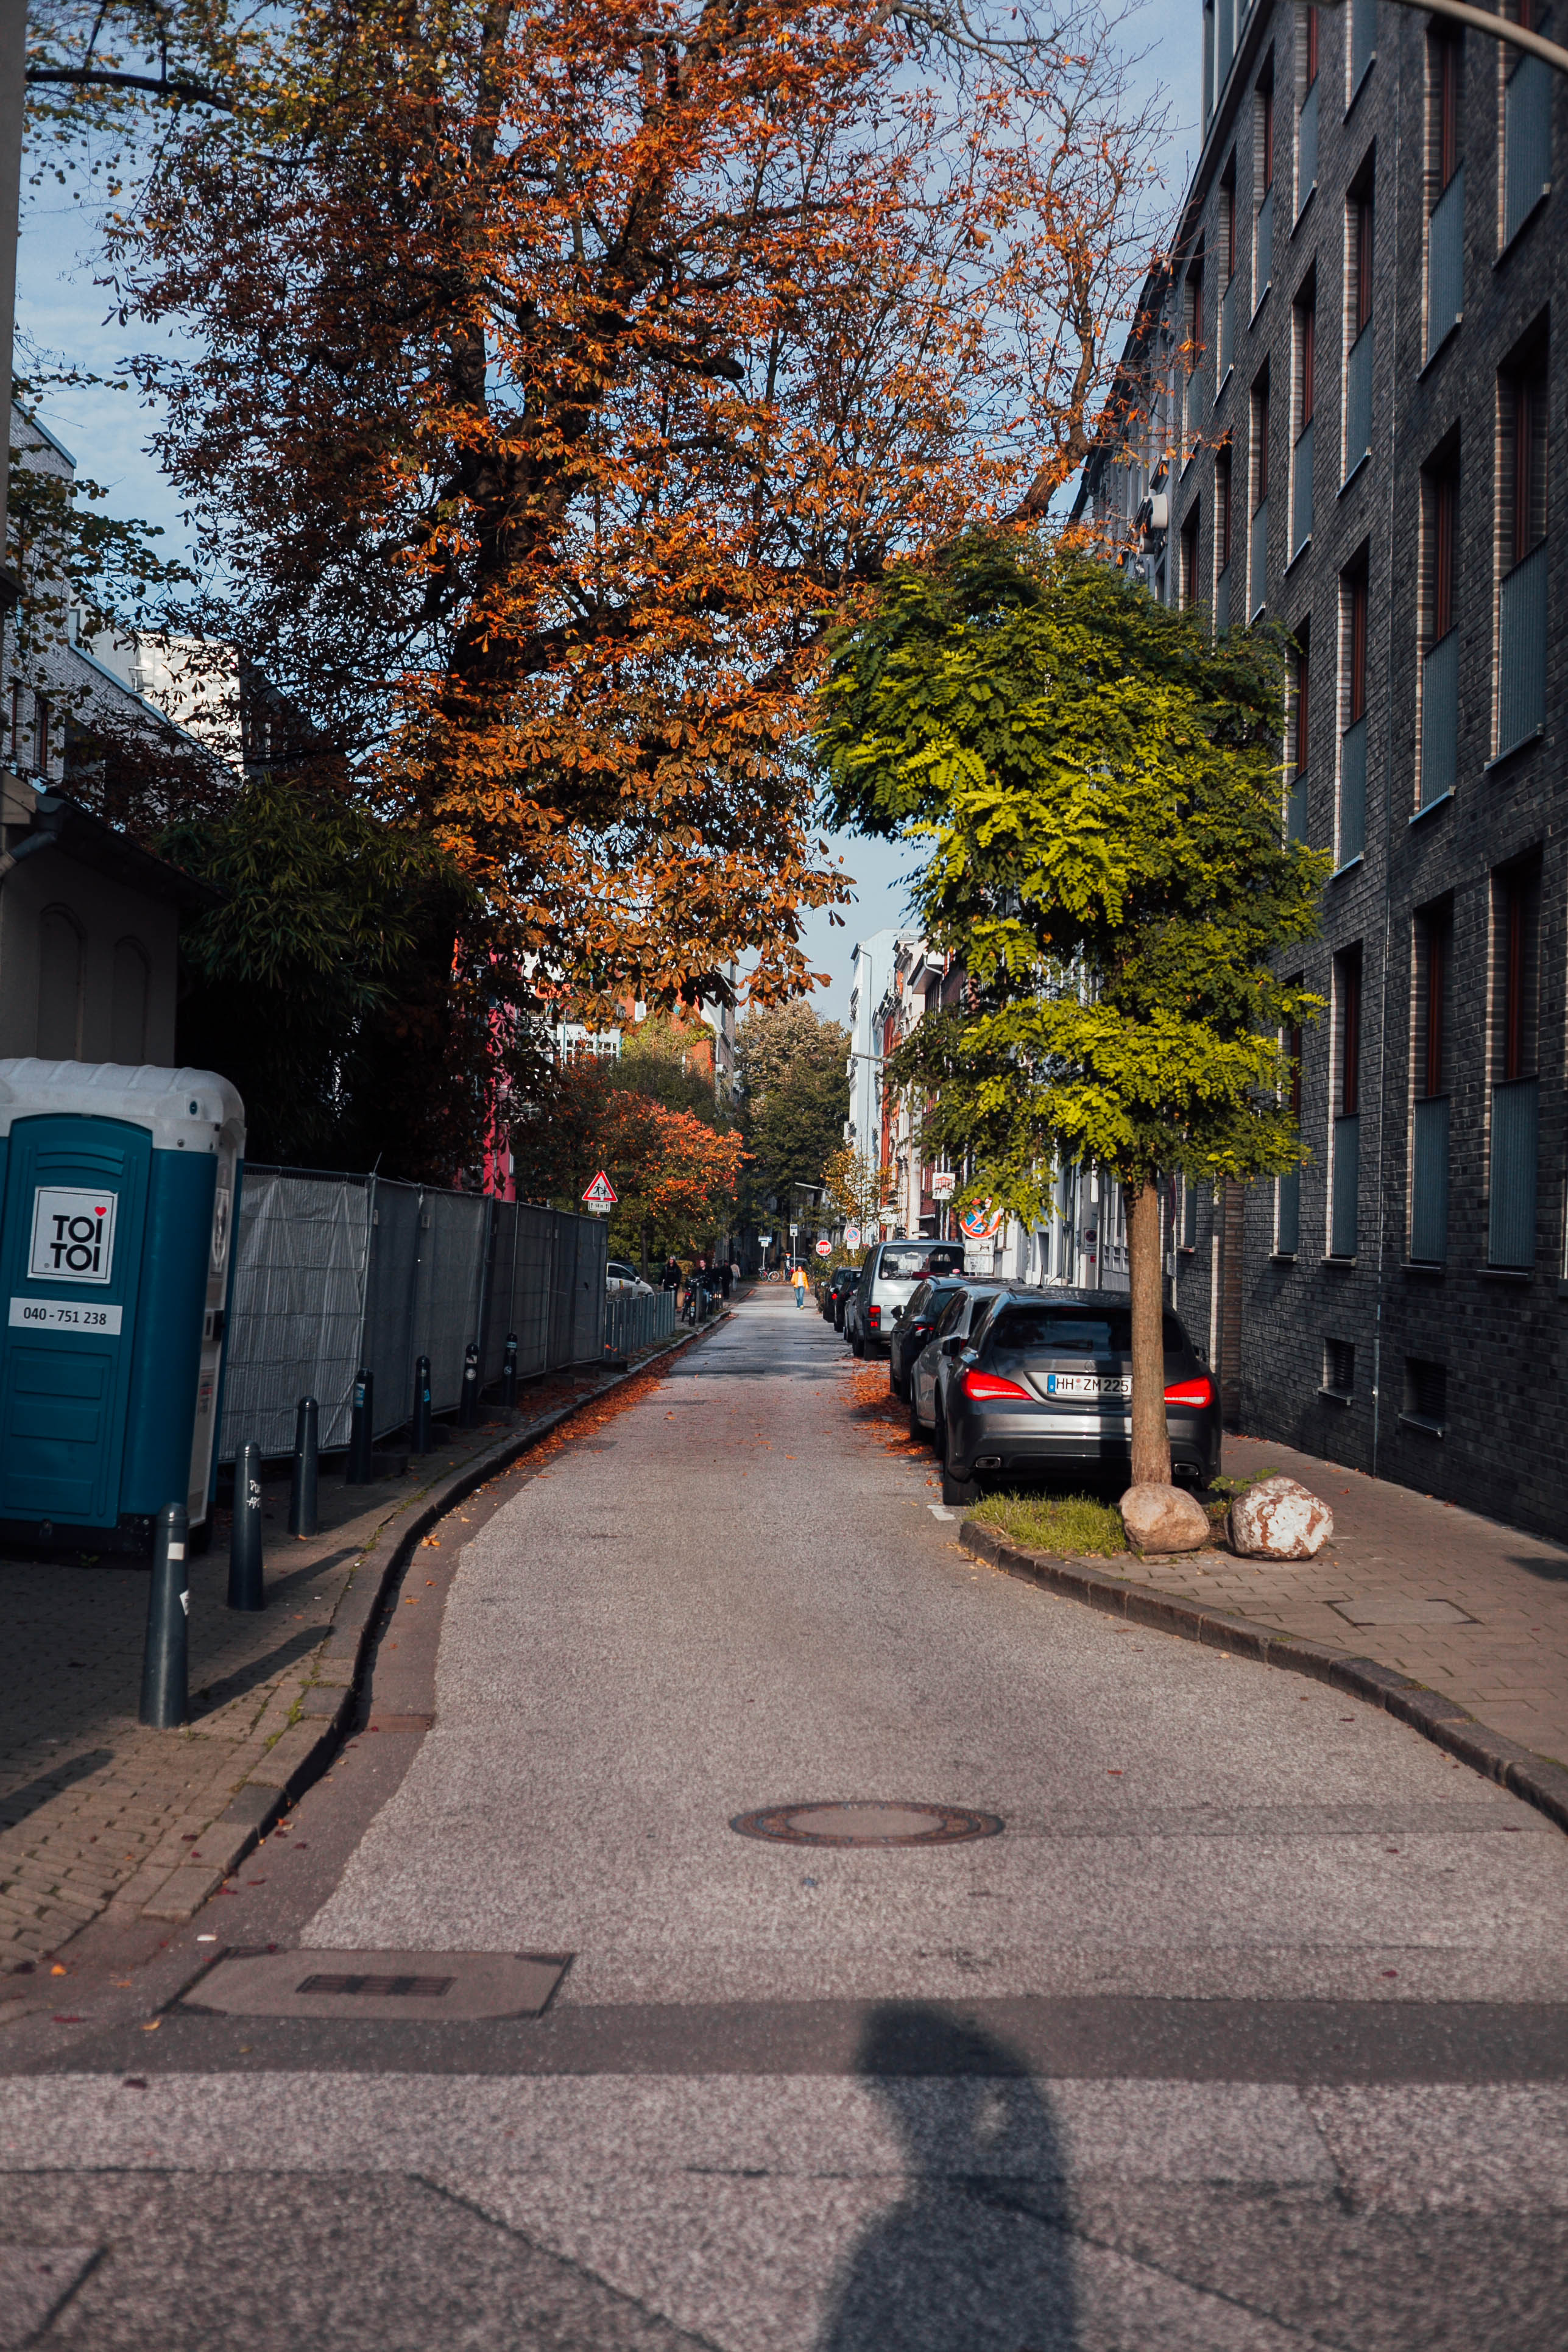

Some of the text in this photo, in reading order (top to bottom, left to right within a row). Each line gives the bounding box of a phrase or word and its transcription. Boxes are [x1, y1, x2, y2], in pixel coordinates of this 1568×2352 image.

[52, 1215, 103, 1244] TOI
[50, 1243, 101, 1272] TOI
[23, 1307, 46, 1320] 040
[57, 1310, 79, 1323] 751
[83, 1312, 107, 1325] 238
[1056, 1378, 1129, 1393] HH ZM 225
